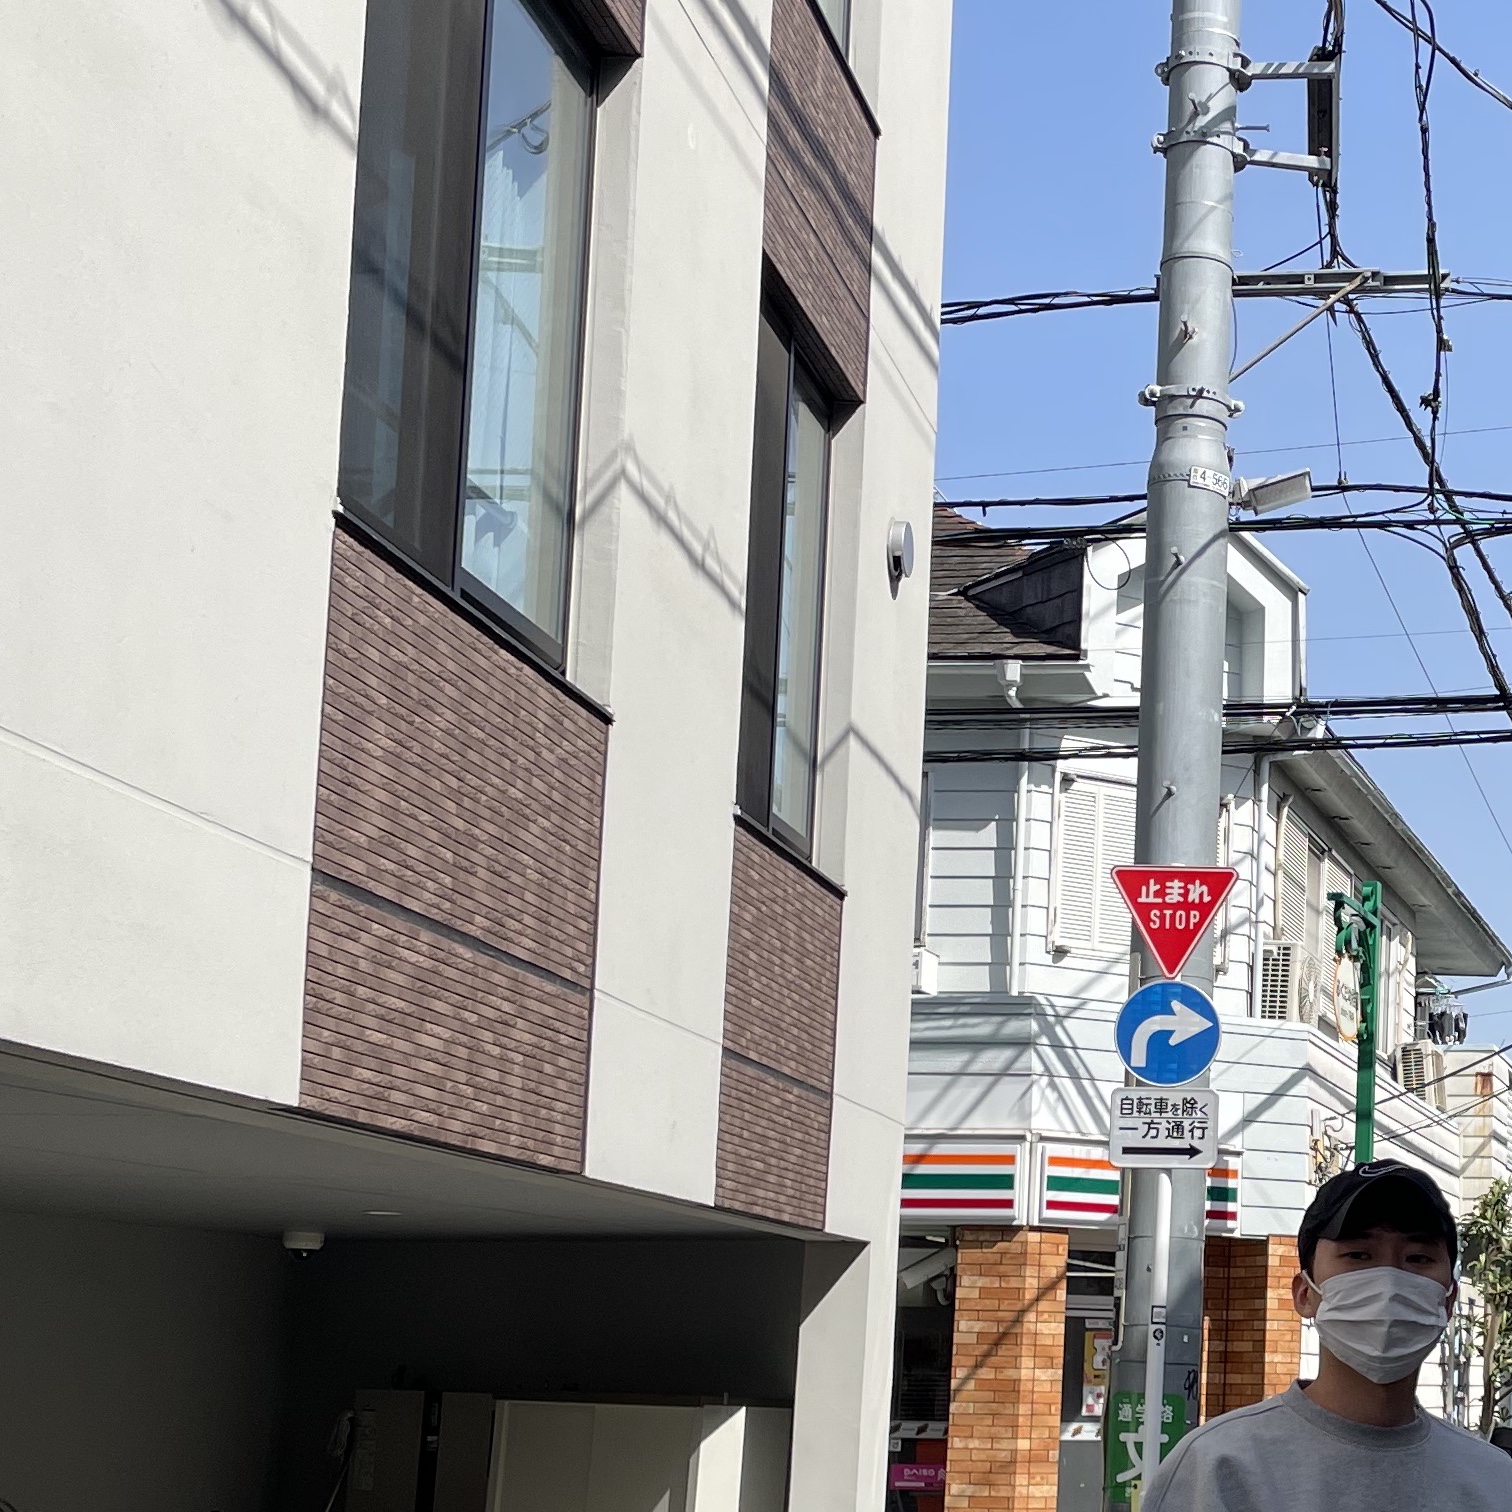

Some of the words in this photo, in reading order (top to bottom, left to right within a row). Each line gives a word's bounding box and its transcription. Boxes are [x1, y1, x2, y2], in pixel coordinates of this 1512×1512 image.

[1137, 879, 1212, 904] 止まれ
[1149, 909, 1200, 929] STOP
[1119, 1096, 1209, 1116] 自転車を除く
[1118, 1120, 1209, 1140] 一方通行
